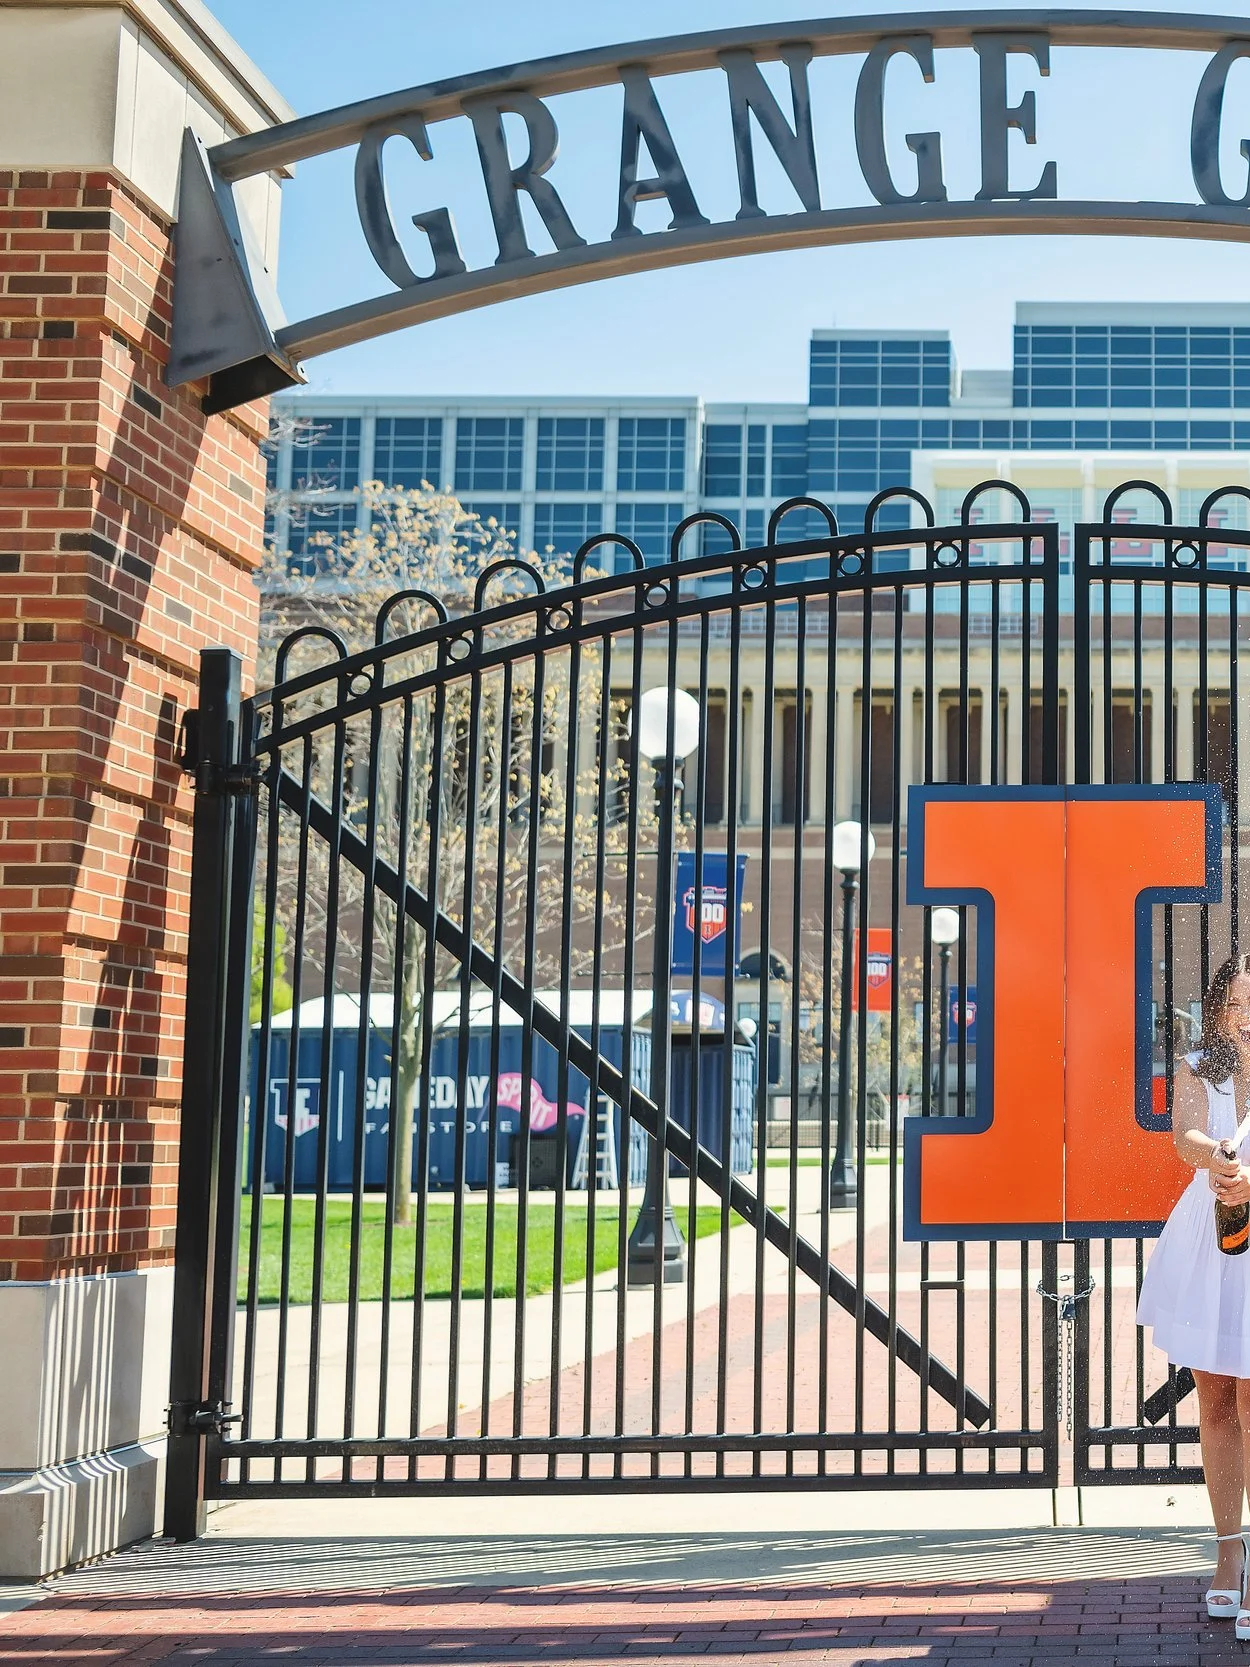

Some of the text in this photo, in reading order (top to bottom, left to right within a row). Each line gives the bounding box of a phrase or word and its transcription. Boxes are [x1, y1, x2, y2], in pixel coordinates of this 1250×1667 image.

[354, 33, 1058, 290] GRANGE
[701, 903, 725, 923] 00
[365, 1075, 553, 1129] GADAY SPIT
